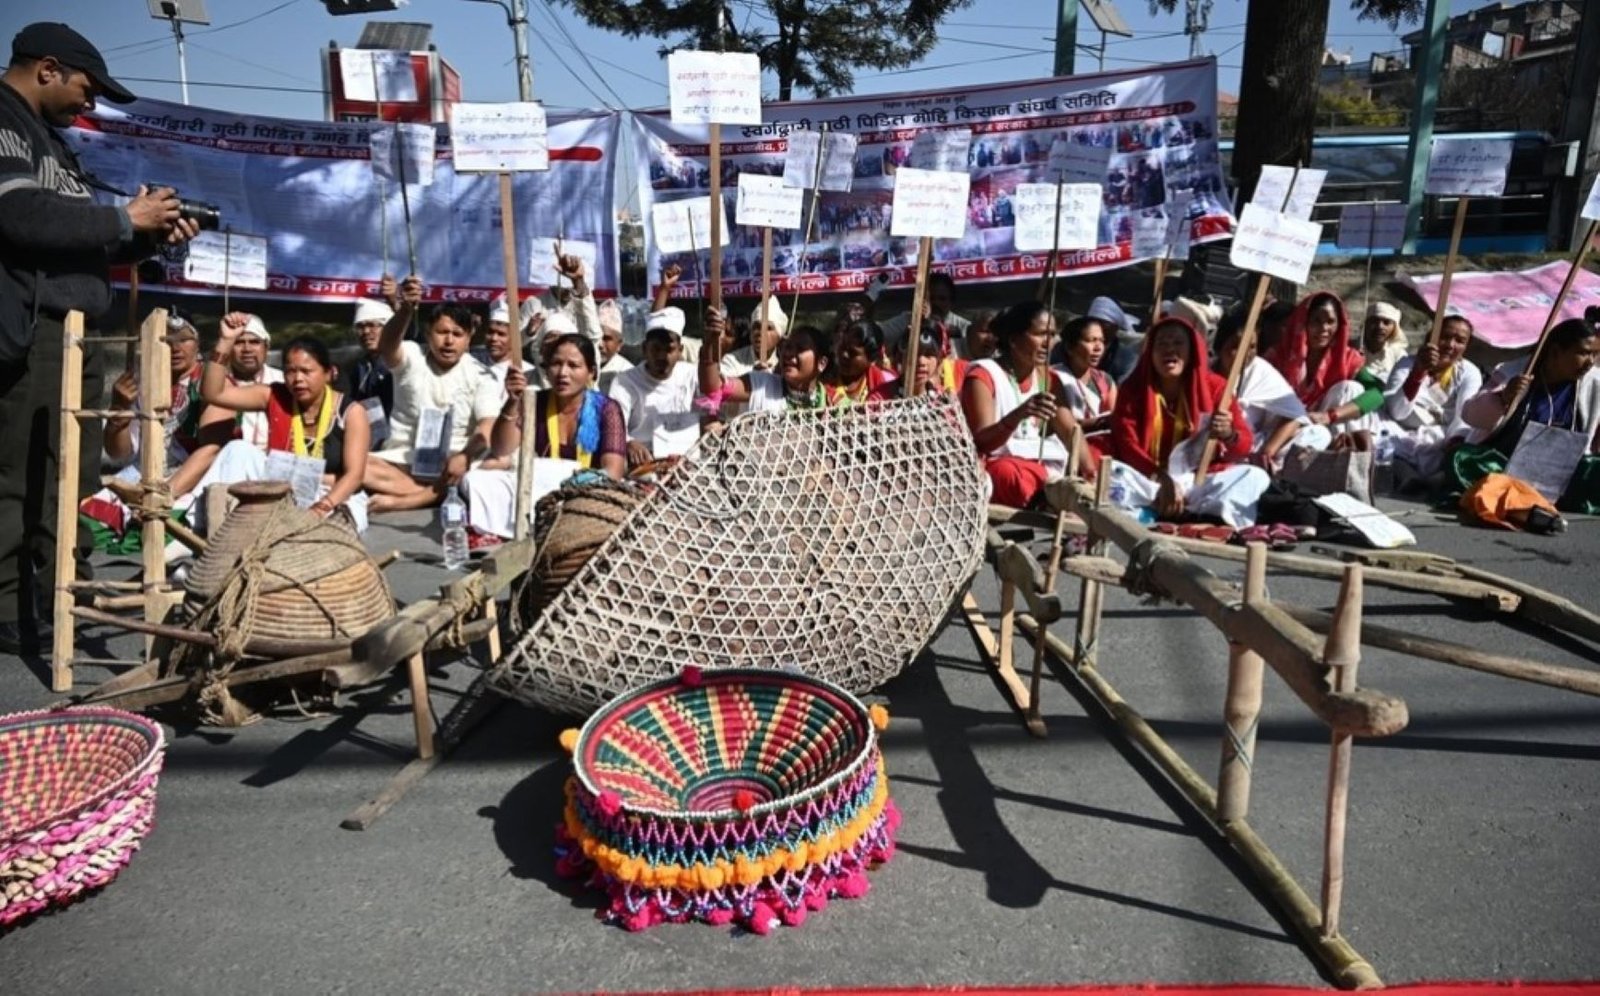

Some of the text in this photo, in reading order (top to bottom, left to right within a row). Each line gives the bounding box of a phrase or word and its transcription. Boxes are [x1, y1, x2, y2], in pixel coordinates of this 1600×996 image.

[954, 104, 1010, 120] किसान
[1018, 95, 1059, 113] संघर्ष
[1063, 90, 1117, 109] समिति
[982, 258, 1014, 275] दिन
[1020, 255, 1049, 271] कि
[1062, 246, 1121, 266] नमिल्ने
[308, 280, 356, 294] काम
